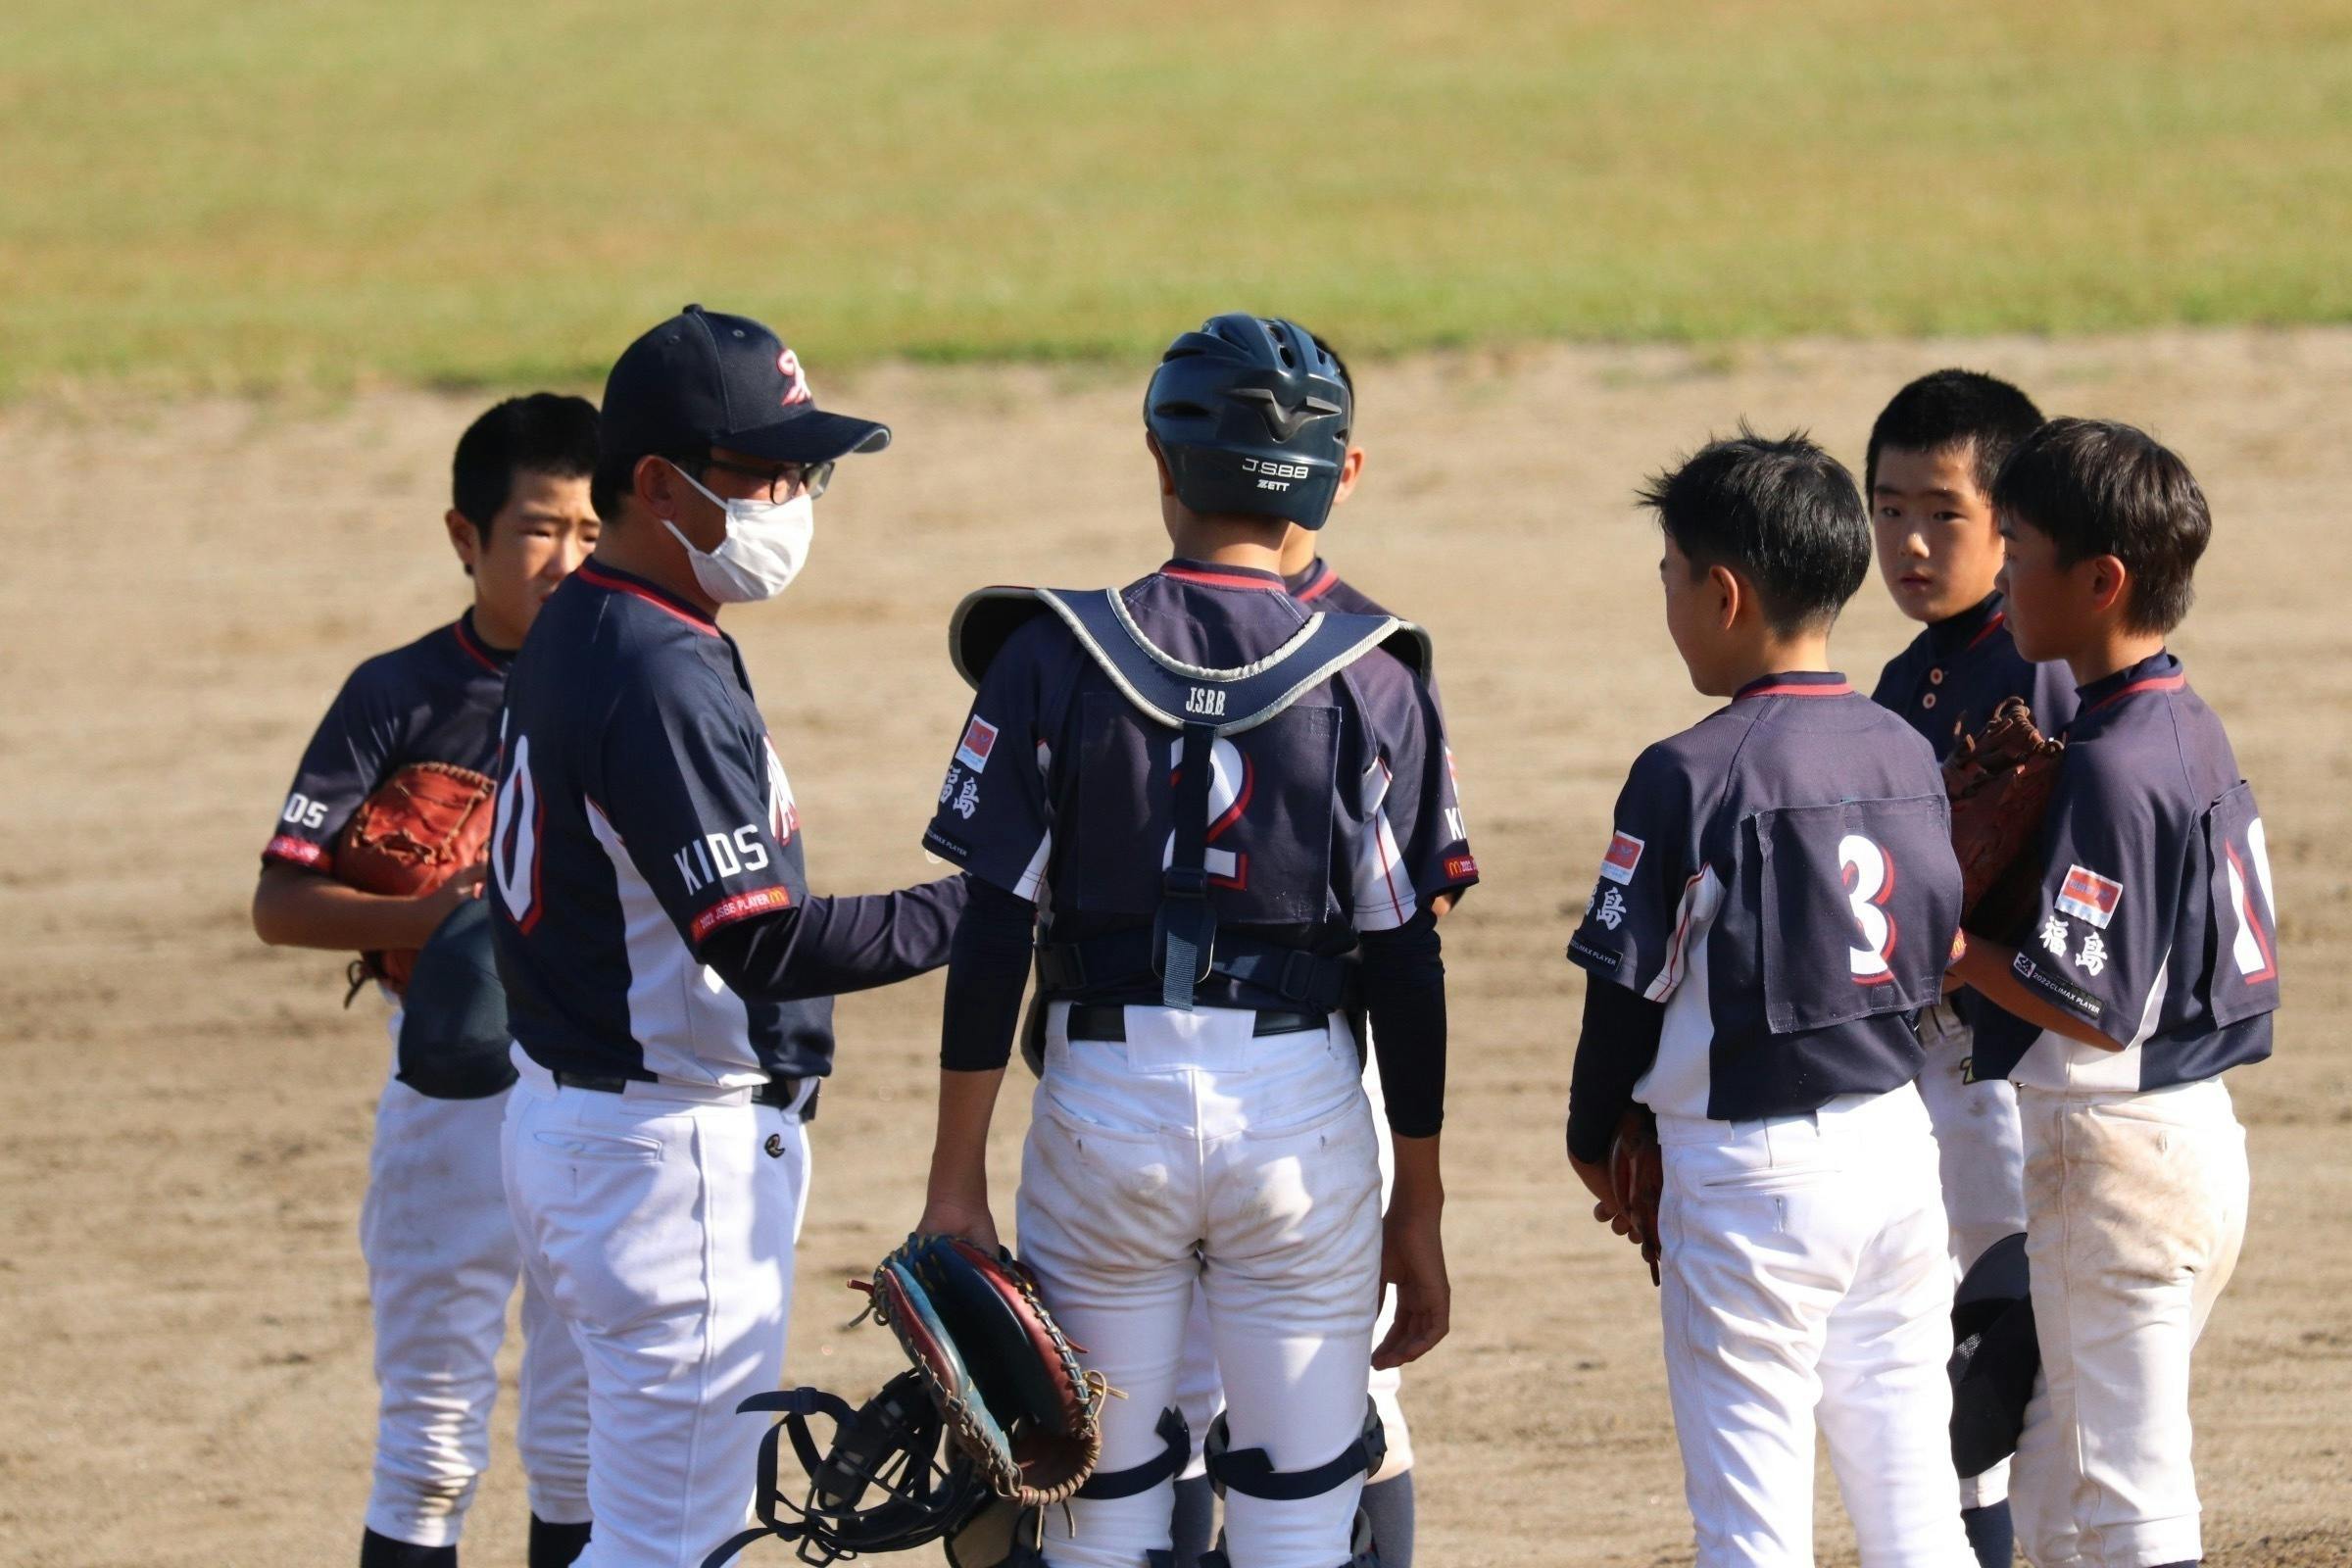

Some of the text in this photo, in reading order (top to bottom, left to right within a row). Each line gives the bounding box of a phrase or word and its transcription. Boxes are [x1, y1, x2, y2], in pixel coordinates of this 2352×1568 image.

[1256, 479, 1291, 492] ZETT
[492, 708, 549, 936] 0
[673, 823, 769, 896] KIDS
[736, 893, 770, 911] PLAYER
[1838, 834, 1897, 986] 3
[1592, 951, 1617, 966] PLAYER
[2038, 915, 2109, 977] 福島
[2075, 996, 2101, 1014] PLAYER
